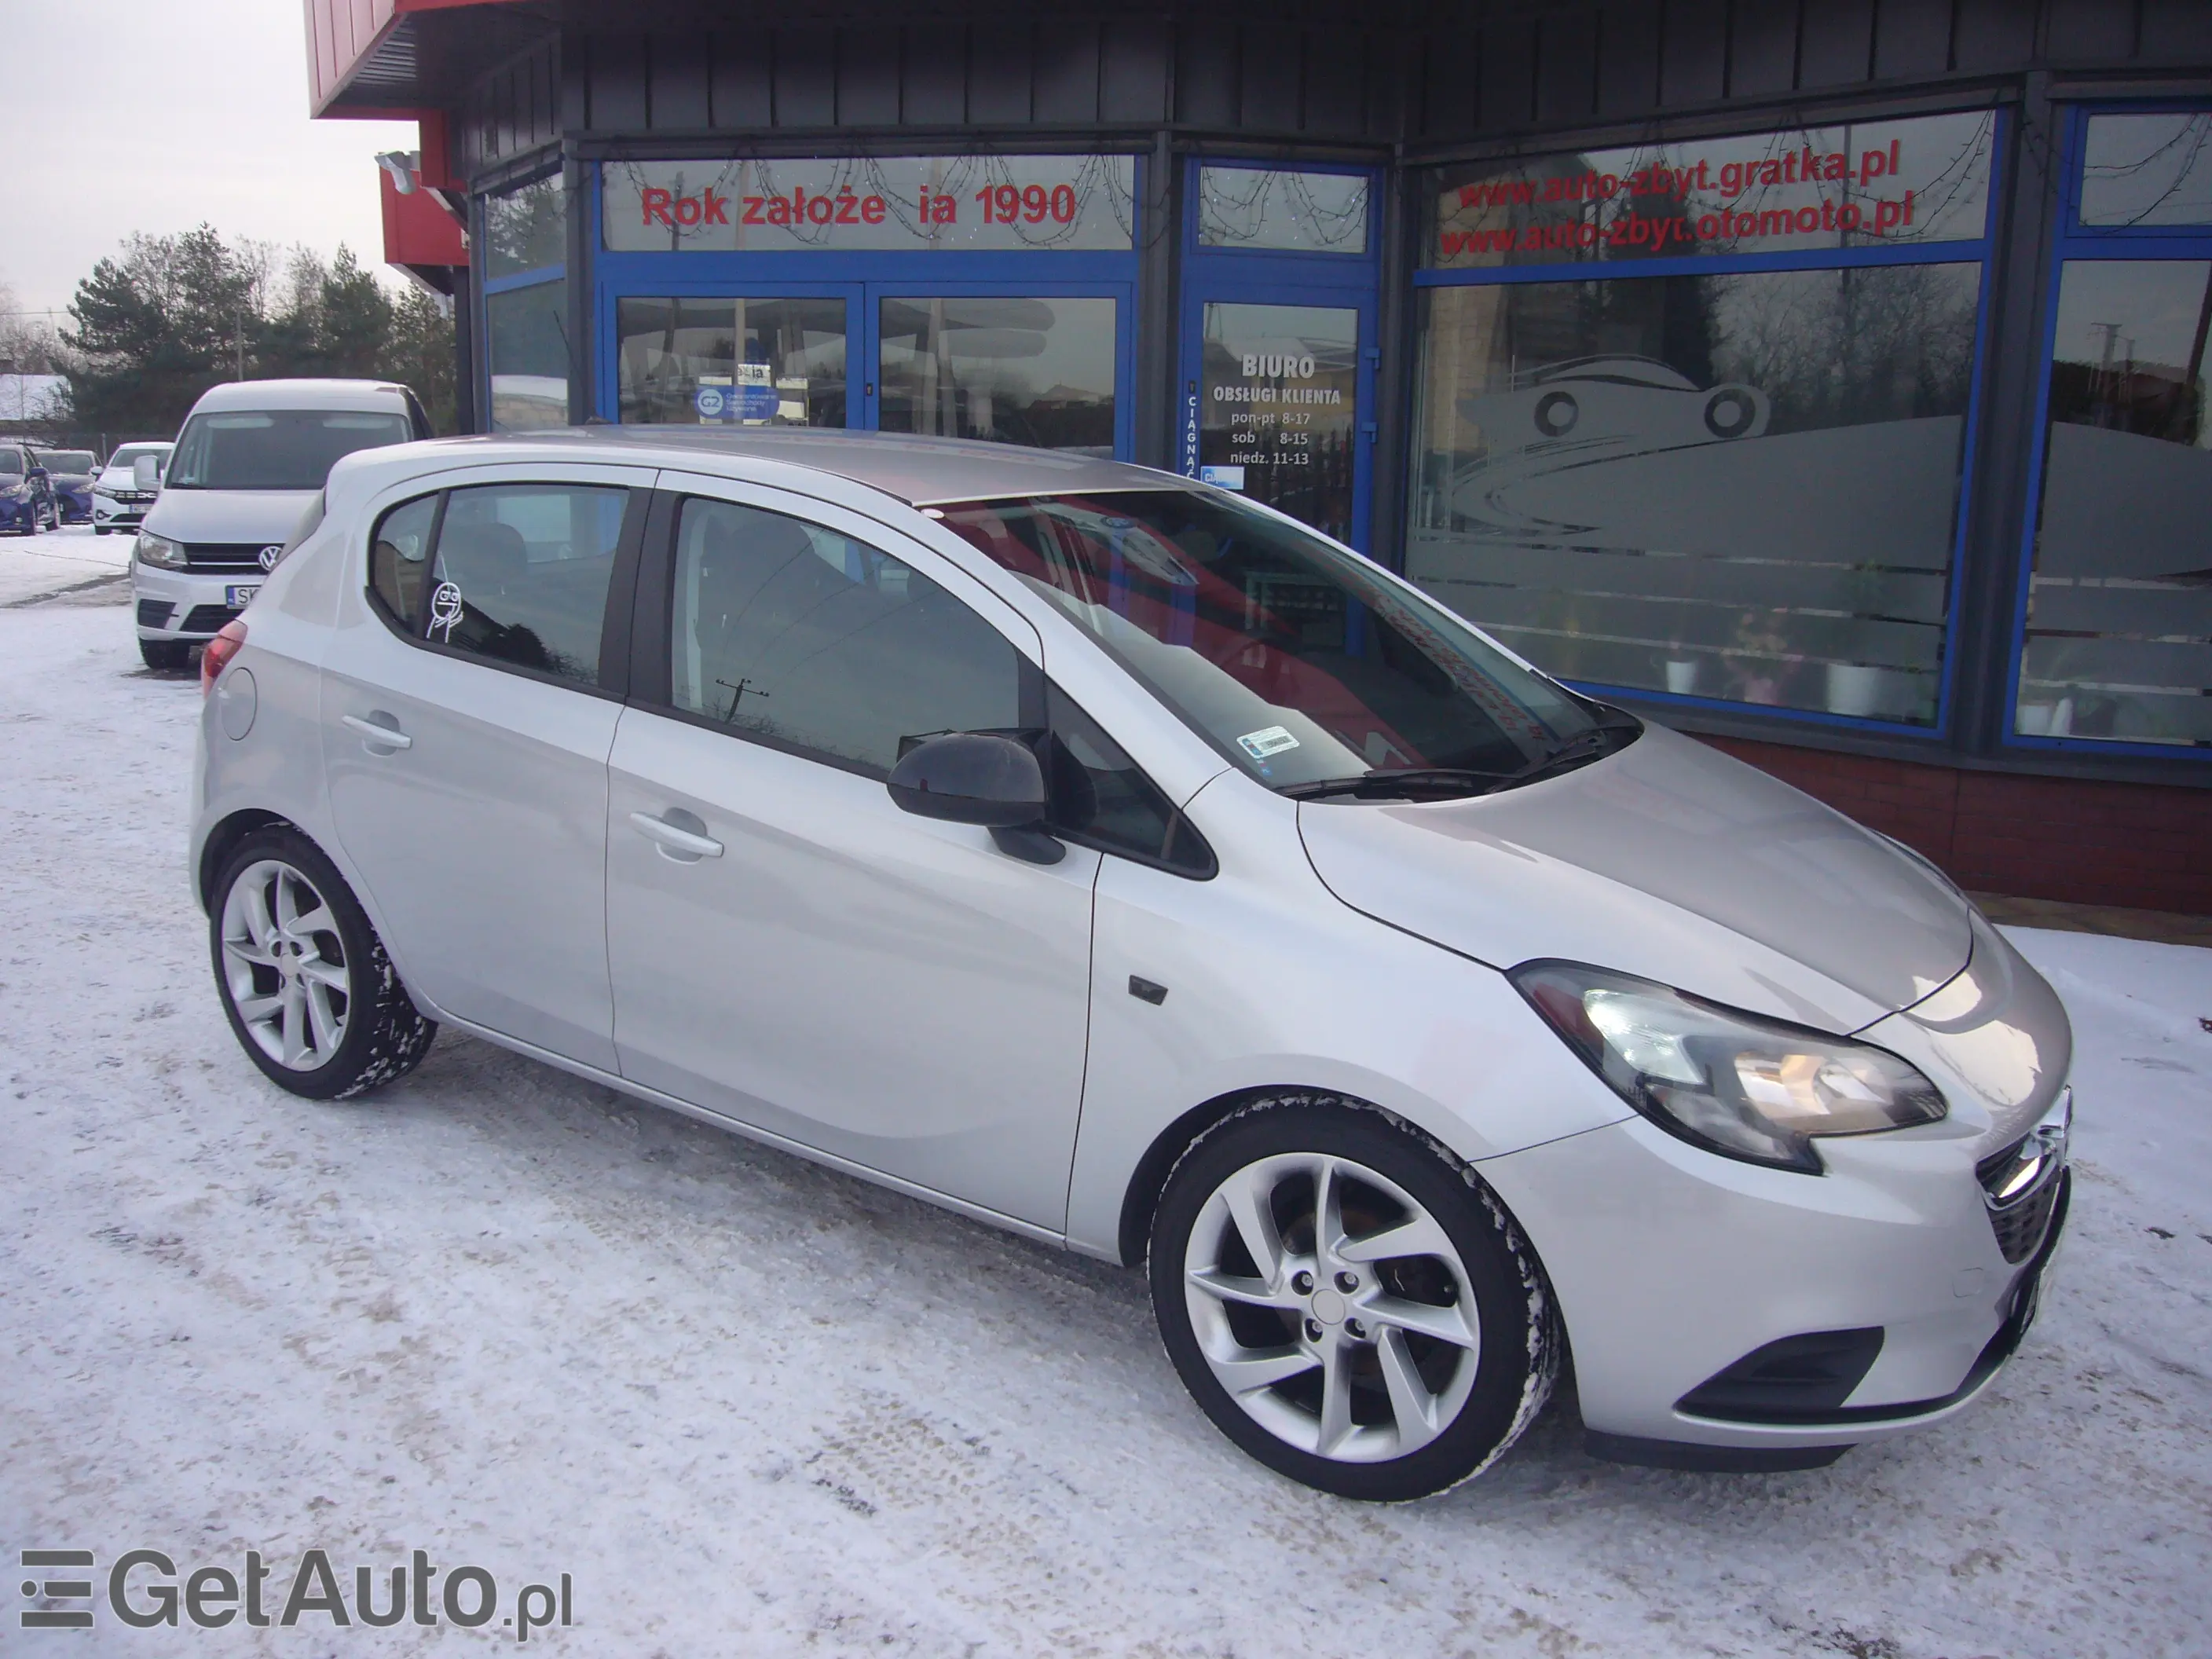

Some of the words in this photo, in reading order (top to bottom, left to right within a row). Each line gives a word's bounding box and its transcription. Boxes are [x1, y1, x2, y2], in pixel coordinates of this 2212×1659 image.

[1459, 139, 1902, 209] www.auto-zbyt.gratka.pl
[642, 186, 730, 225] Rok
[742, 185, 887, 225] założe
[919, 185, 957, 224] ia
[976, 185, 1075, 224] 1990
[1441, 190, 1915, 255] www.auto-zbyt.otomoto.pl
[1242, 354, 1316, 379] BIURO
[701, 396, 720, 408] G2
[1213, 386, 1276, 403] OBSŁUGI
[1282, 389, 1341, 405] KLIENTA
[1231, 412, 1275, 427] pon-pt
[1282, 412, 1311, 425] 8-17
[1232, 430, 1255, 444] sob
[1280, 432, 1309, 445] 8-15
[1230, 451, 1269, 465] niedz.
[1273, 452, 1309, 465] 11-13
